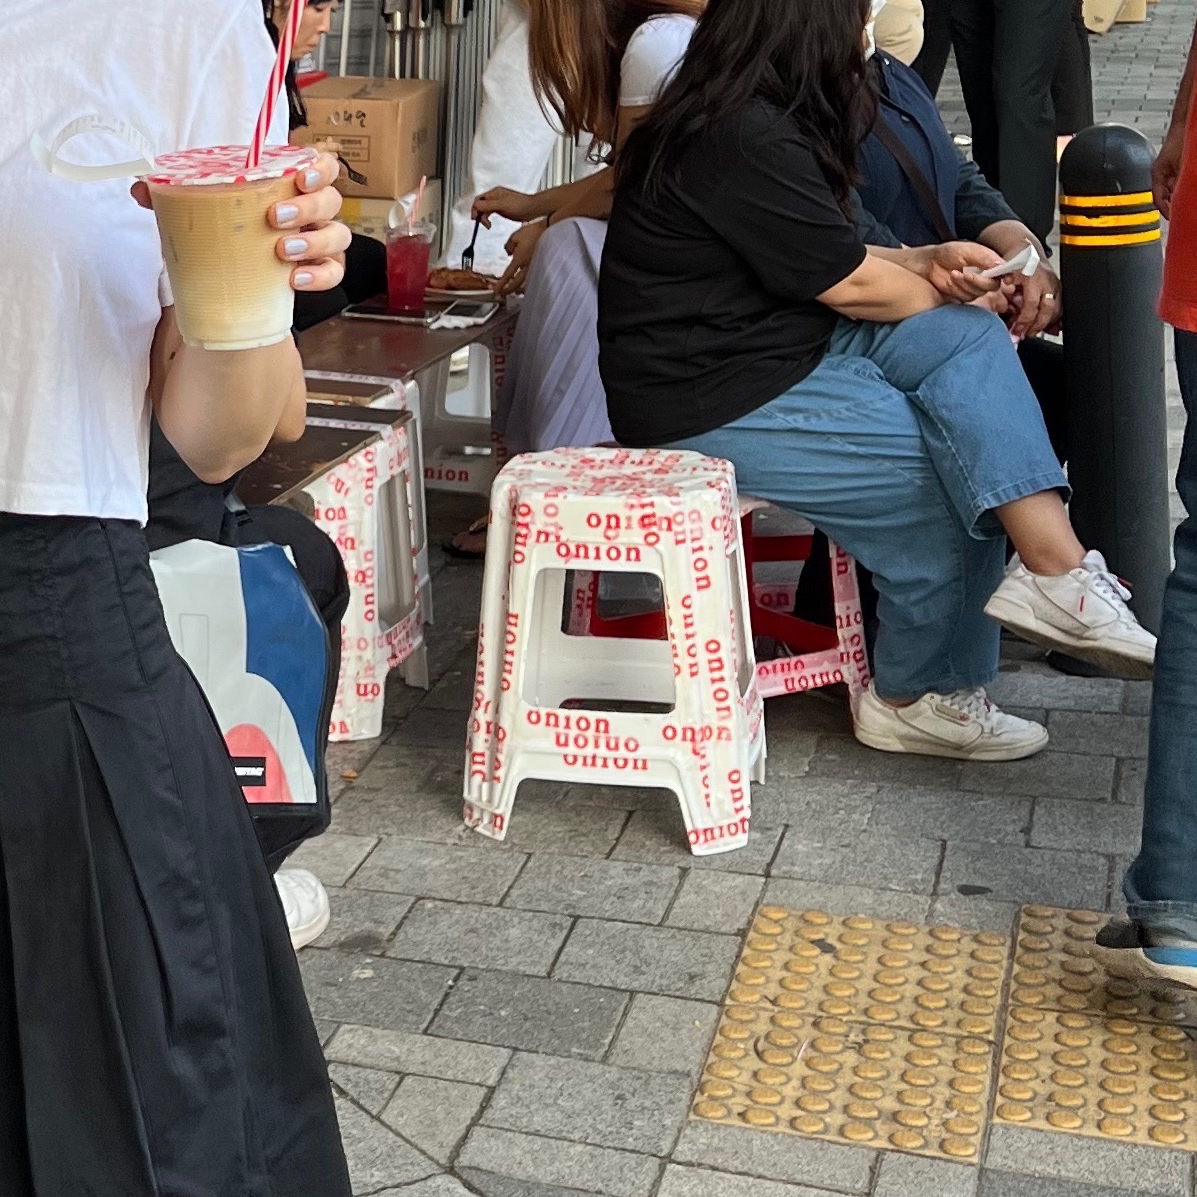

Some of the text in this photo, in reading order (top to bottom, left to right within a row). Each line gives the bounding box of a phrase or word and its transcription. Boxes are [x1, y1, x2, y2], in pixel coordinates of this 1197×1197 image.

[556, 541, 641, 562] onion
[688, 509, 714, 592] onion
[705, 638, 734, 721] onion
[784, 669, 844, 692] onion
[527, 709, 610, 734] onion
[555, 732, 640, 753] onion
